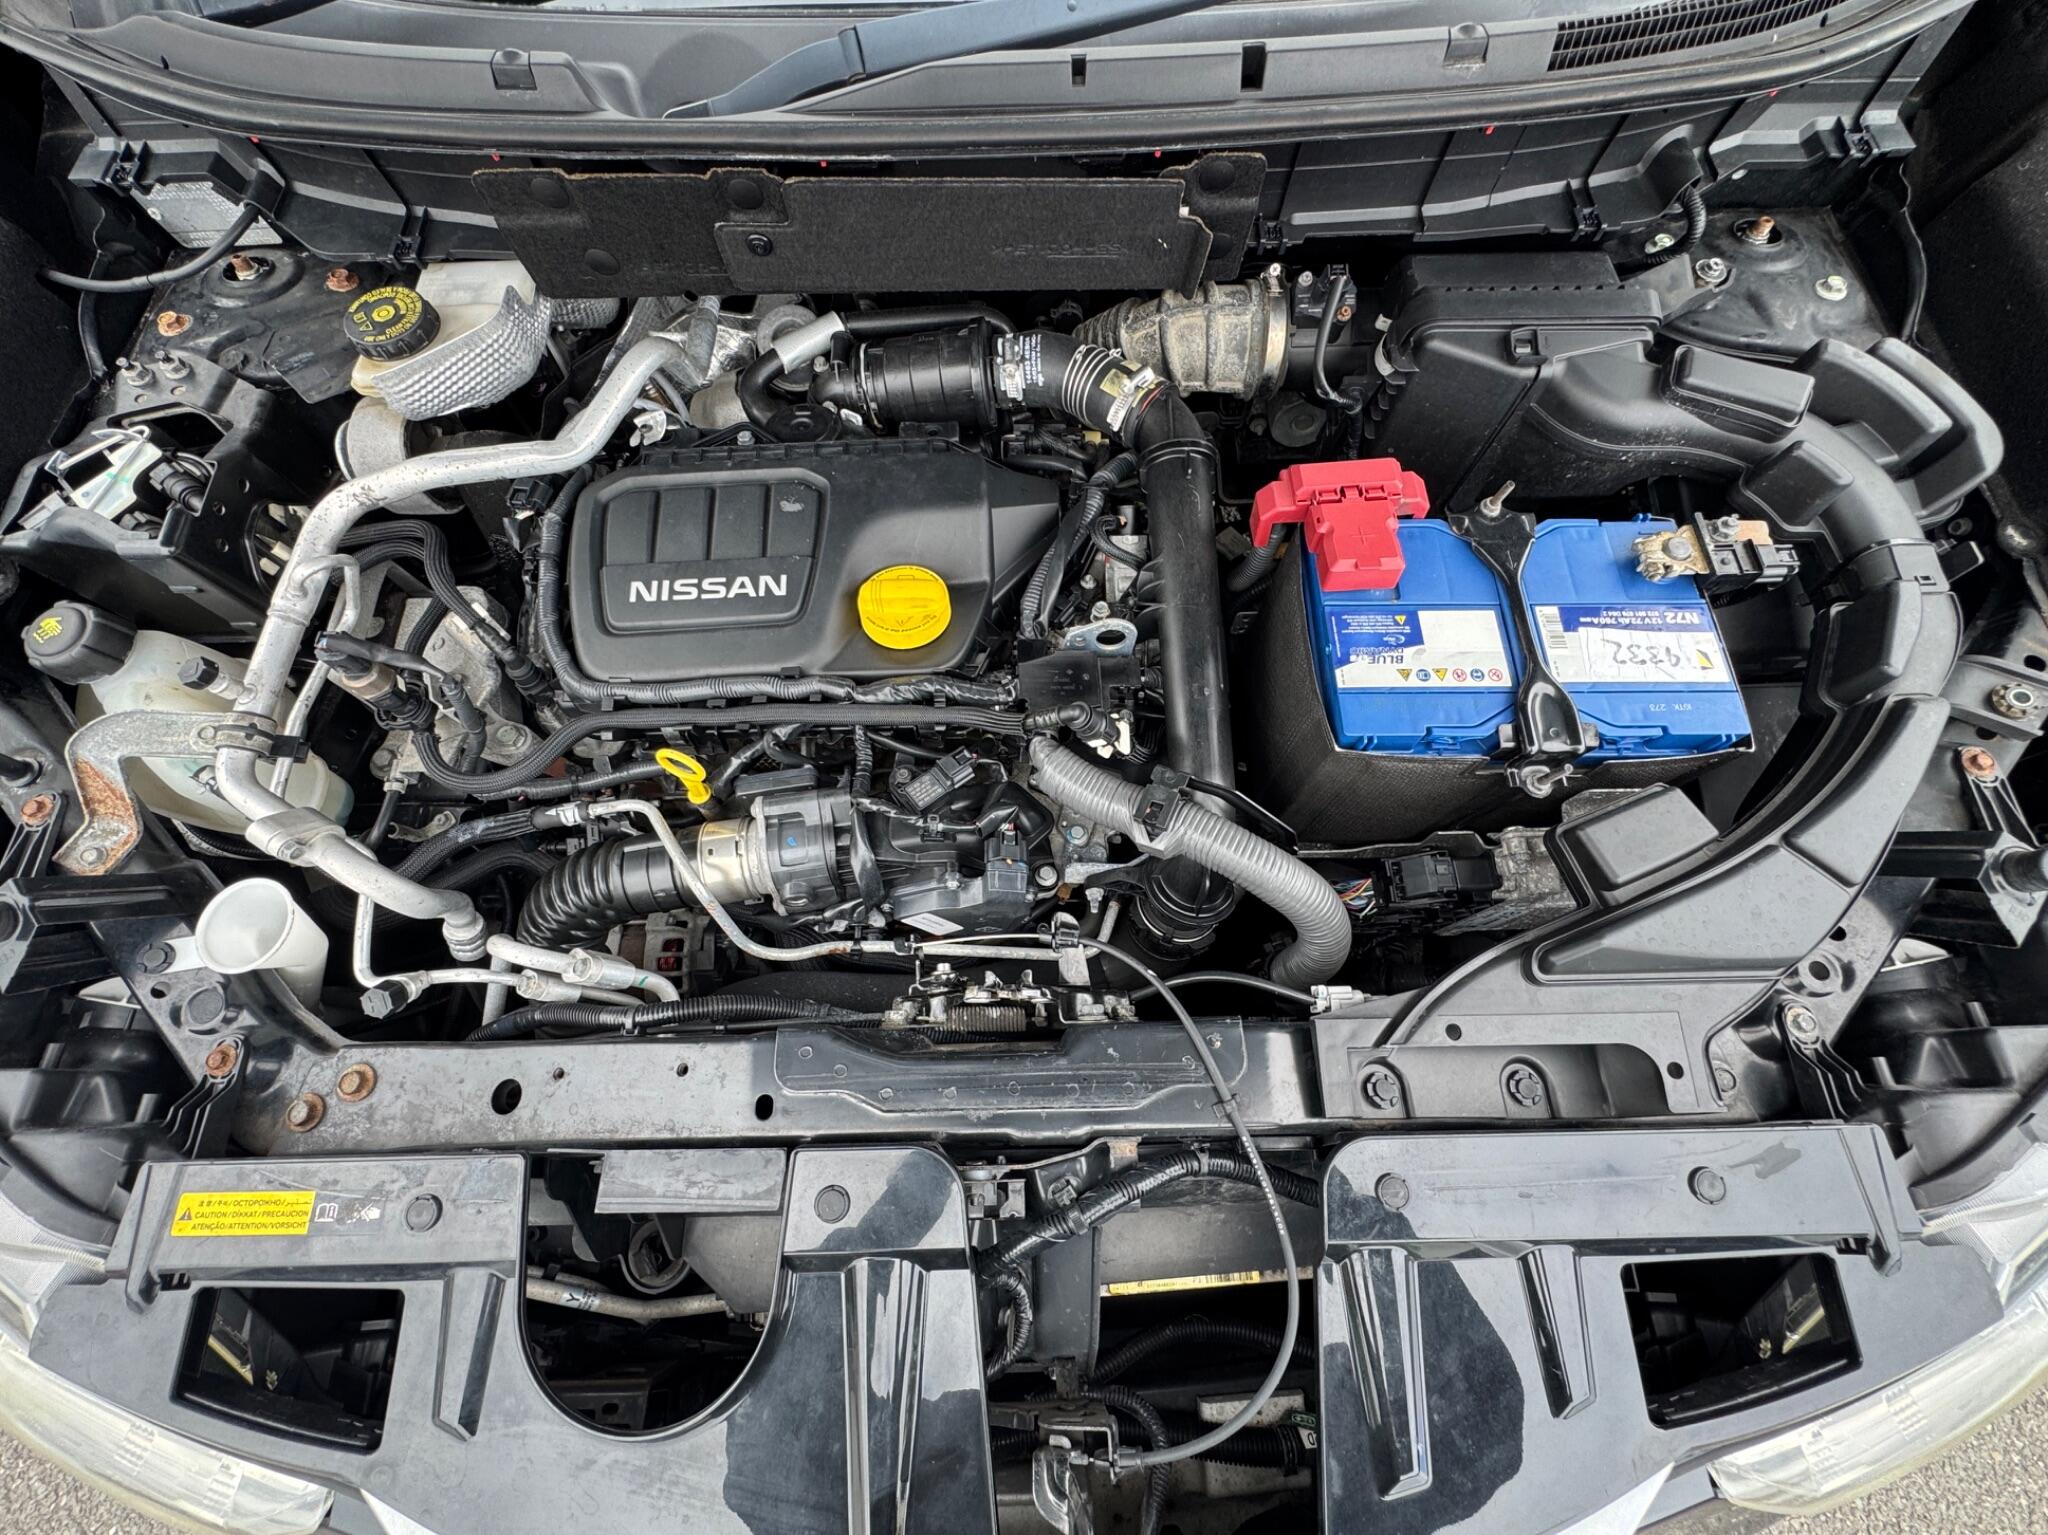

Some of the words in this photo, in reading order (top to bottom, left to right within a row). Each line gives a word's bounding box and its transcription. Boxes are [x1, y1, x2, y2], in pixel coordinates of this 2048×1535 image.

[629, 574, 787, 603] NISSAN
[1664, 612, 1700, 624] N72
[1368, 655, 1403, 664] BLUE
